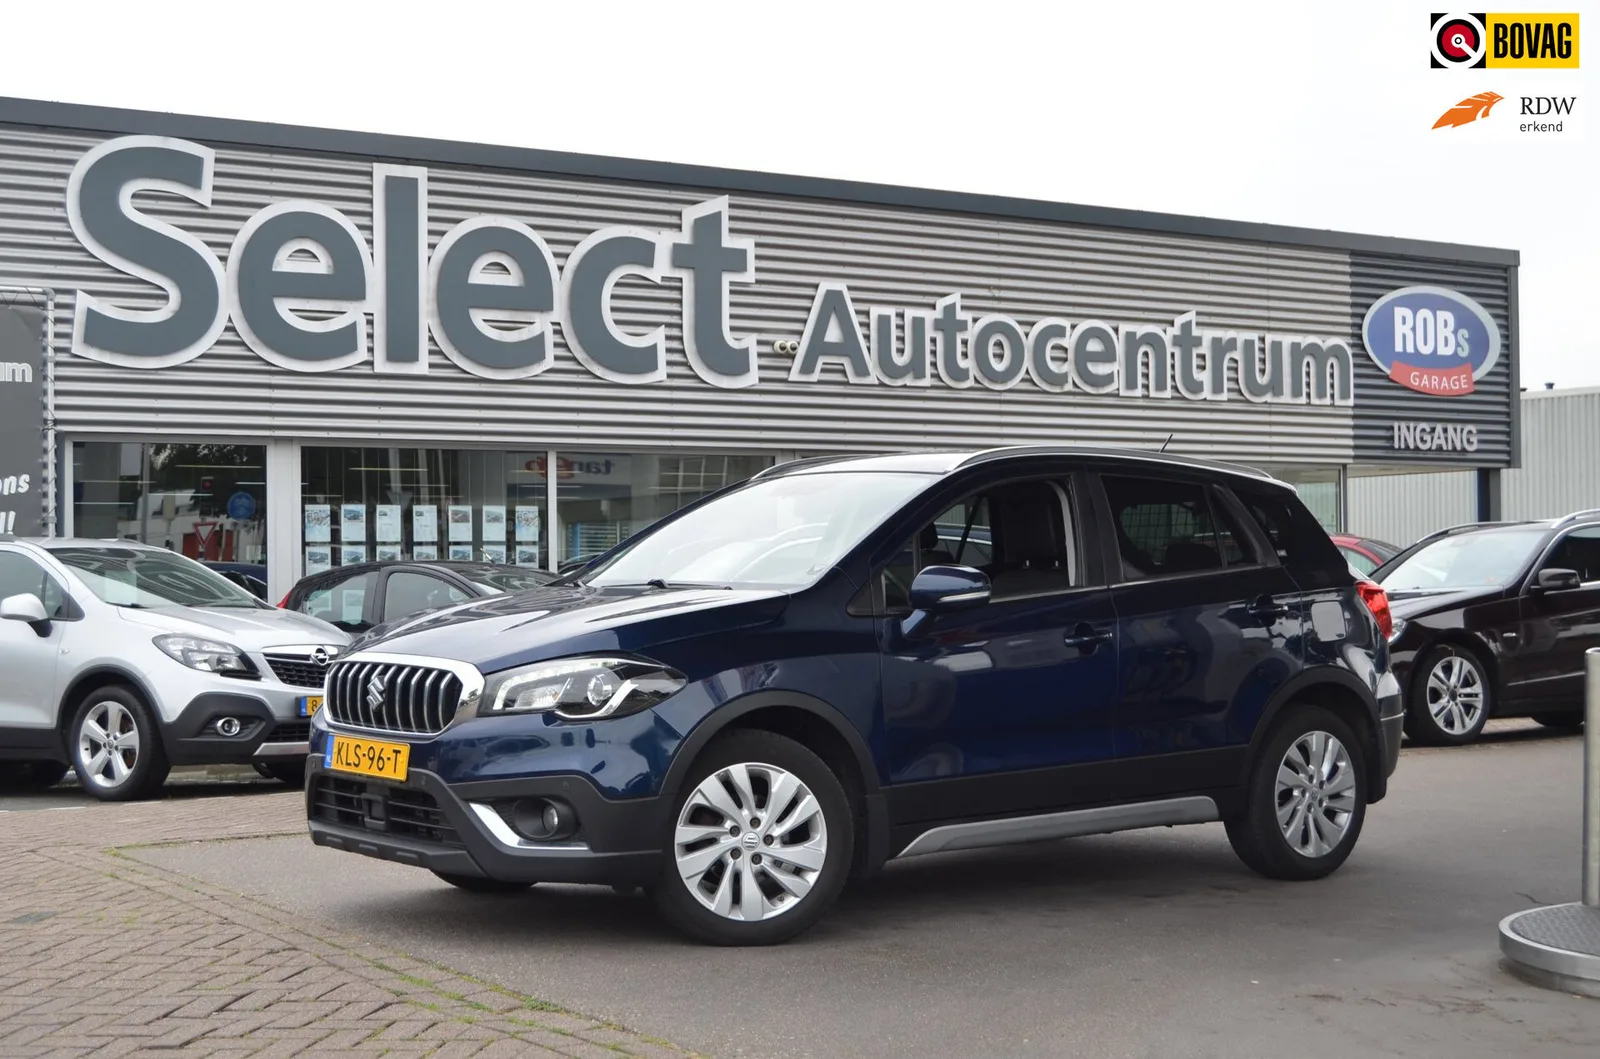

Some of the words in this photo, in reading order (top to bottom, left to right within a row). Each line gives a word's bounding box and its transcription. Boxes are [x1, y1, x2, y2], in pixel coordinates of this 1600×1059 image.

[66, 135, 759, 389] Select
[788, 281, 1355, 407] Autocentrum
[1393, 306, 1470, 358] ROBs
[1410, 371, 1468, 390] GARAGE
[1393, 421, 1478, 452] INGANG
[336, 741, 401, 774] KLS-96-T
